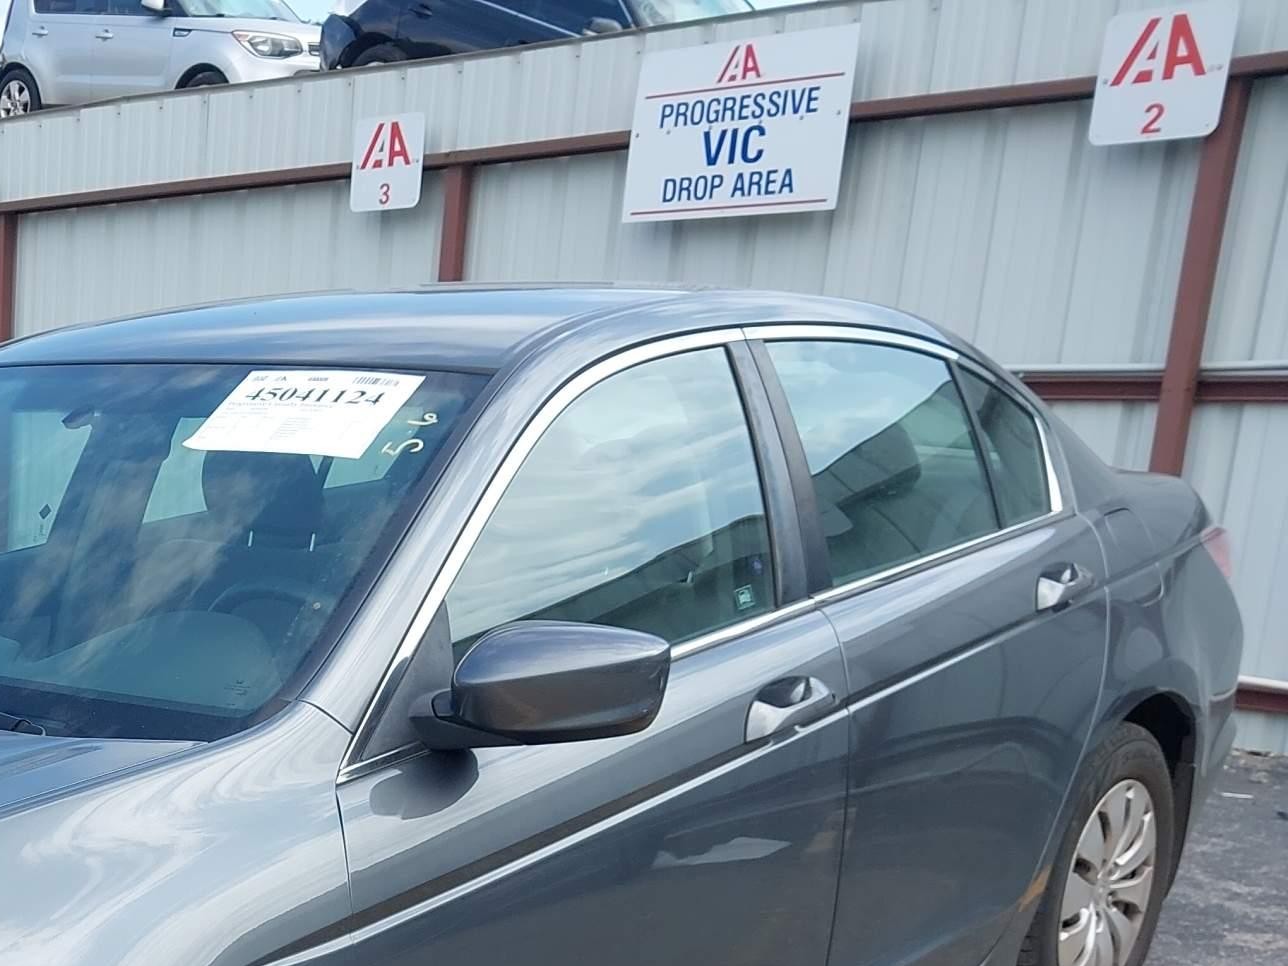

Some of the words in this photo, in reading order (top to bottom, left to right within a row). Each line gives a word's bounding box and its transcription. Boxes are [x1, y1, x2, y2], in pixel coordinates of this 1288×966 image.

[659, 86, 821, 129] PROGRESSIVE
[1140, 102, 1165, 135] 2
[703, 124, 766, 167] VIC
[378, 183, 391, 206] 3
[662, 173, 724, 203] DROP
[730, 167, 795, 199] AREA
[245, 387, 385, 406] 45041124
